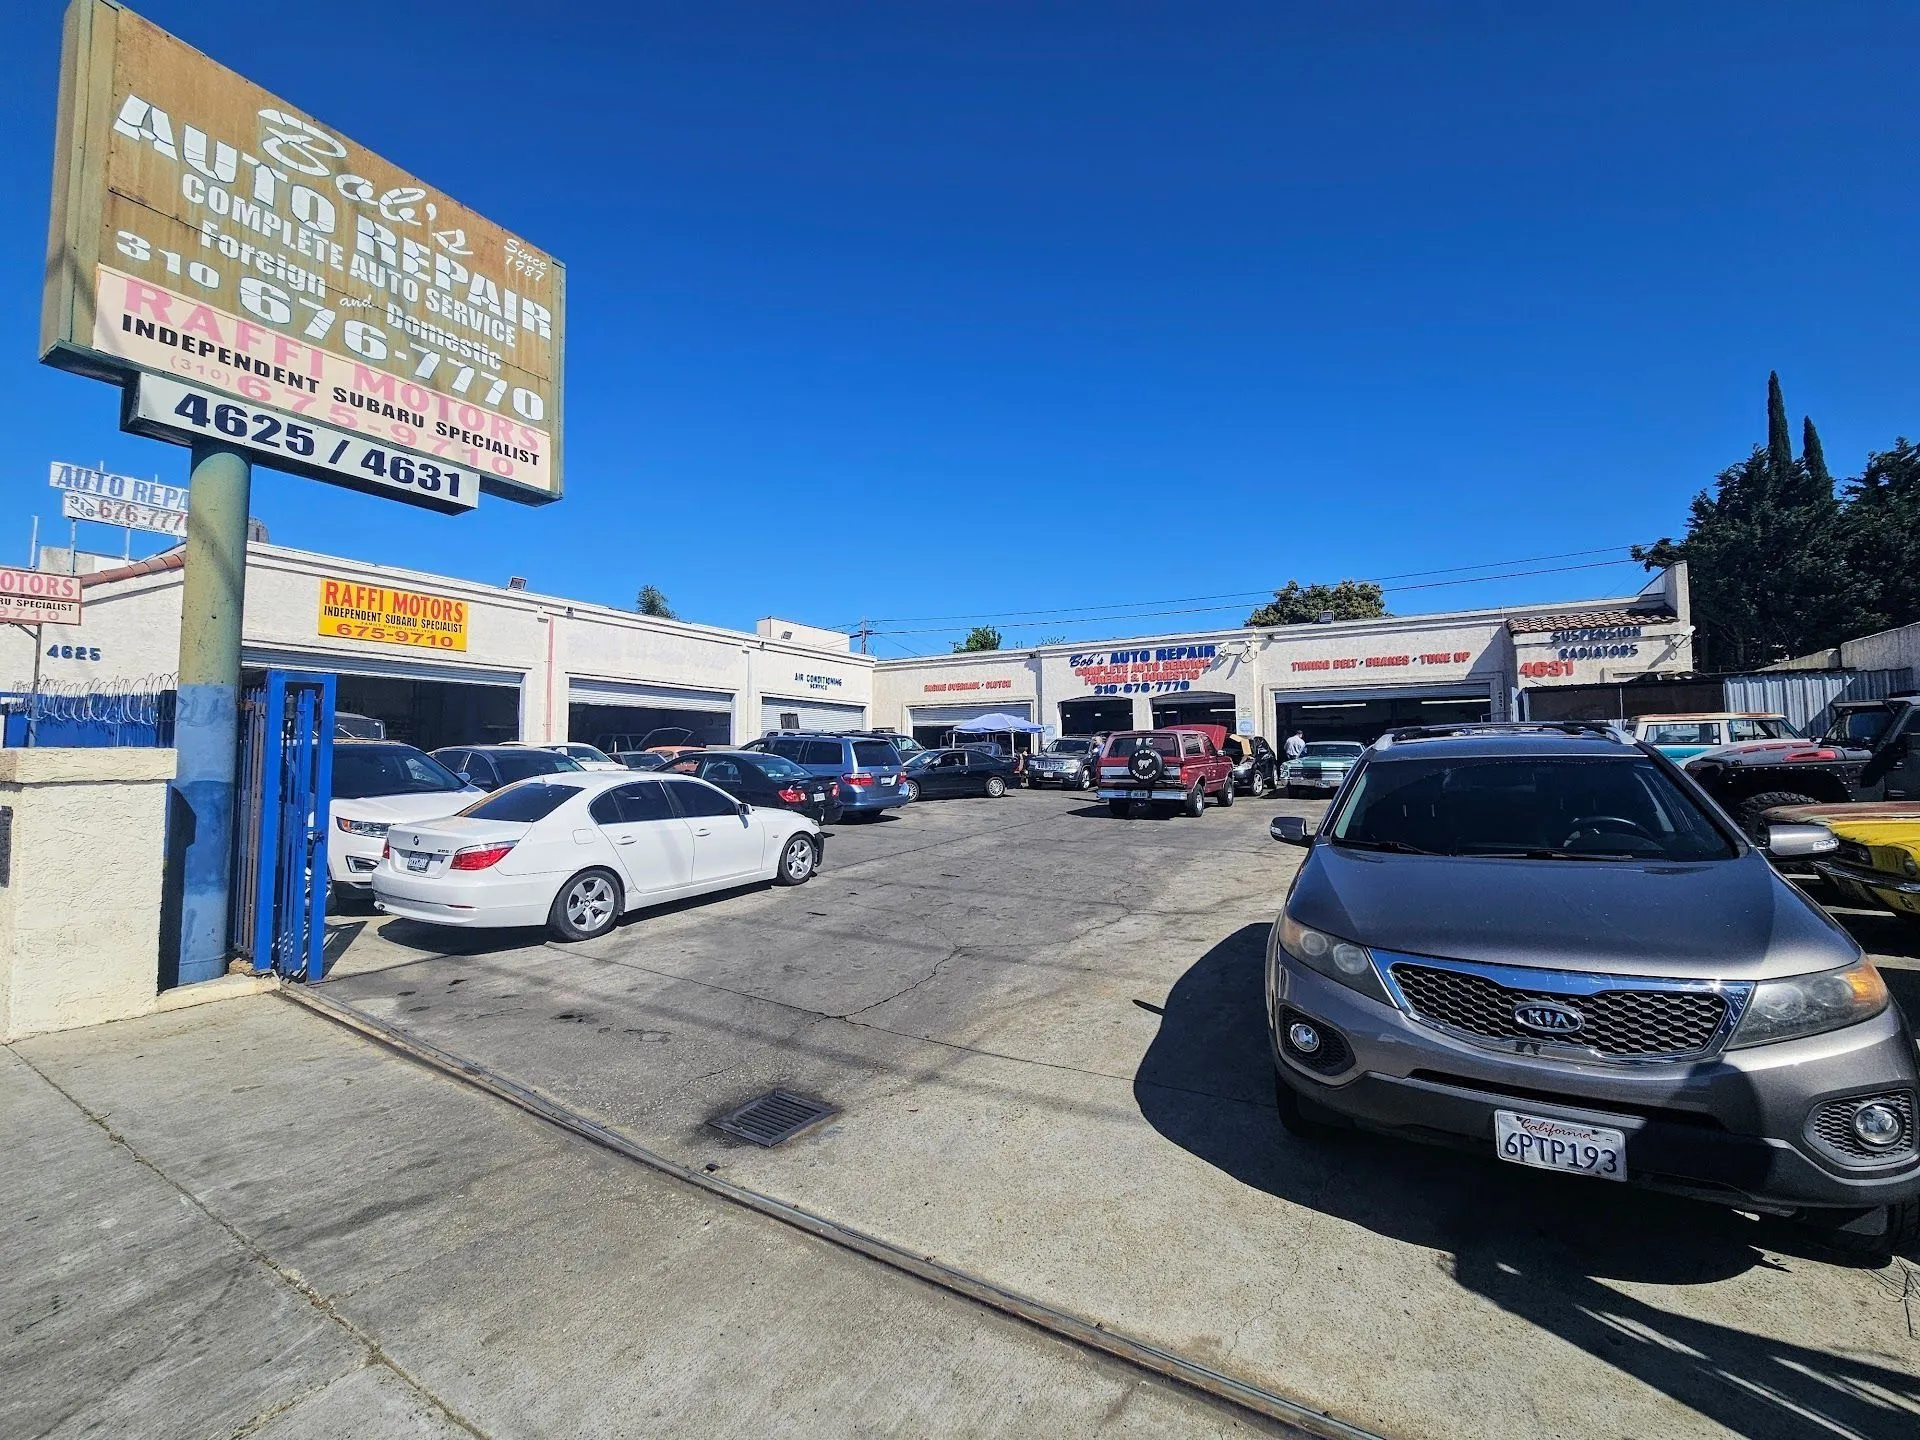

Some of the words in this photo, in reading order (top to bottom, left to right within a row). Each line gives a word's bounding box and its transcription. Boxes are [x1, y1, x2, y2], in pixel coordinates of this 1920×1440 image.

[113, 94, 335, 233] AUTO
[357, 215, 551, 340] REPAIR
[183, 174, 343, 271] COMPLETE
[350, 254, 418, 302] AUTO
[425, 288, 515, 347] SERVICE
[503, 238, 547, 270] Since
[505, 255, 545, 282] 1987
[201, 219, 325, 298] Foreign
[340, 294, 373, 309] and
[387, 301, 502, 370] Domestic
[117, 230, 219, 289] 310
[240, 277, 543, 421] 676-7770
[124, 277, 323, 379] RAFFI
[353, 363, 538, 451] MOTORS
[122, 314, 319, 393] INDEPENDENT
[333, 386, 424, 428] SUBARU
[436, 421, 540, 466] SPECIALIST
[171, 354, 231, 386] (310)
[236, 375, 514, 476] 675-9710
[174, 392, 315, 457] 4625
[360, 447, 460, 498] 4631
[57, 465, 125, 497] AUTO
[16, 599, 73, 612] SPECIALIST
[325, 581, 384, 612] RAFFI
[392, 592, 463, 623] MOTORS
[324, 605, 382, 622] INDEPENDENT
[385, 613, 417, 628] SUBARU
[421, 618, 462, 633] SPECIALIST
[336, 623, 453, 648] 675-9710
[1550, 626, 1641, 642] SUSPENSION
[46, 644, 102, 661] 4625
[1069, 653, 1104, 668] Bob's
[1110, 650, 1151, 664] AUTO
[1155, 645, 1216, 661] REPAIR
[1291, 660, 1330, 672] TIMING
[1333, 658, 1358, 669] BELT
[1365, 655, 1410, 668] BRAKES
[1419, 653, 1451, 665] TUNE
[1453, 652, 1470, 663] UP
[1558, 644, 1638, 660] RADIATORS
[1075, 664, 1129, 677] COMPLETE
[1131, 660, 1160, 673] AUTO
[1162, 658, 1211, 670] SERVICE
[1085, 673, 1127, 686] FOREIGN
[1130, 673, 1139, 683] &
[1142, 670, 1200, 682] DOMESTIC
[1519, 658, 1575, 678] 4631
[1528, 1009, 1570, 1028] KIA
[1521, 1118, 1598, 1143] California
[1504, 1132, 1617, 1174] 6PTP193
